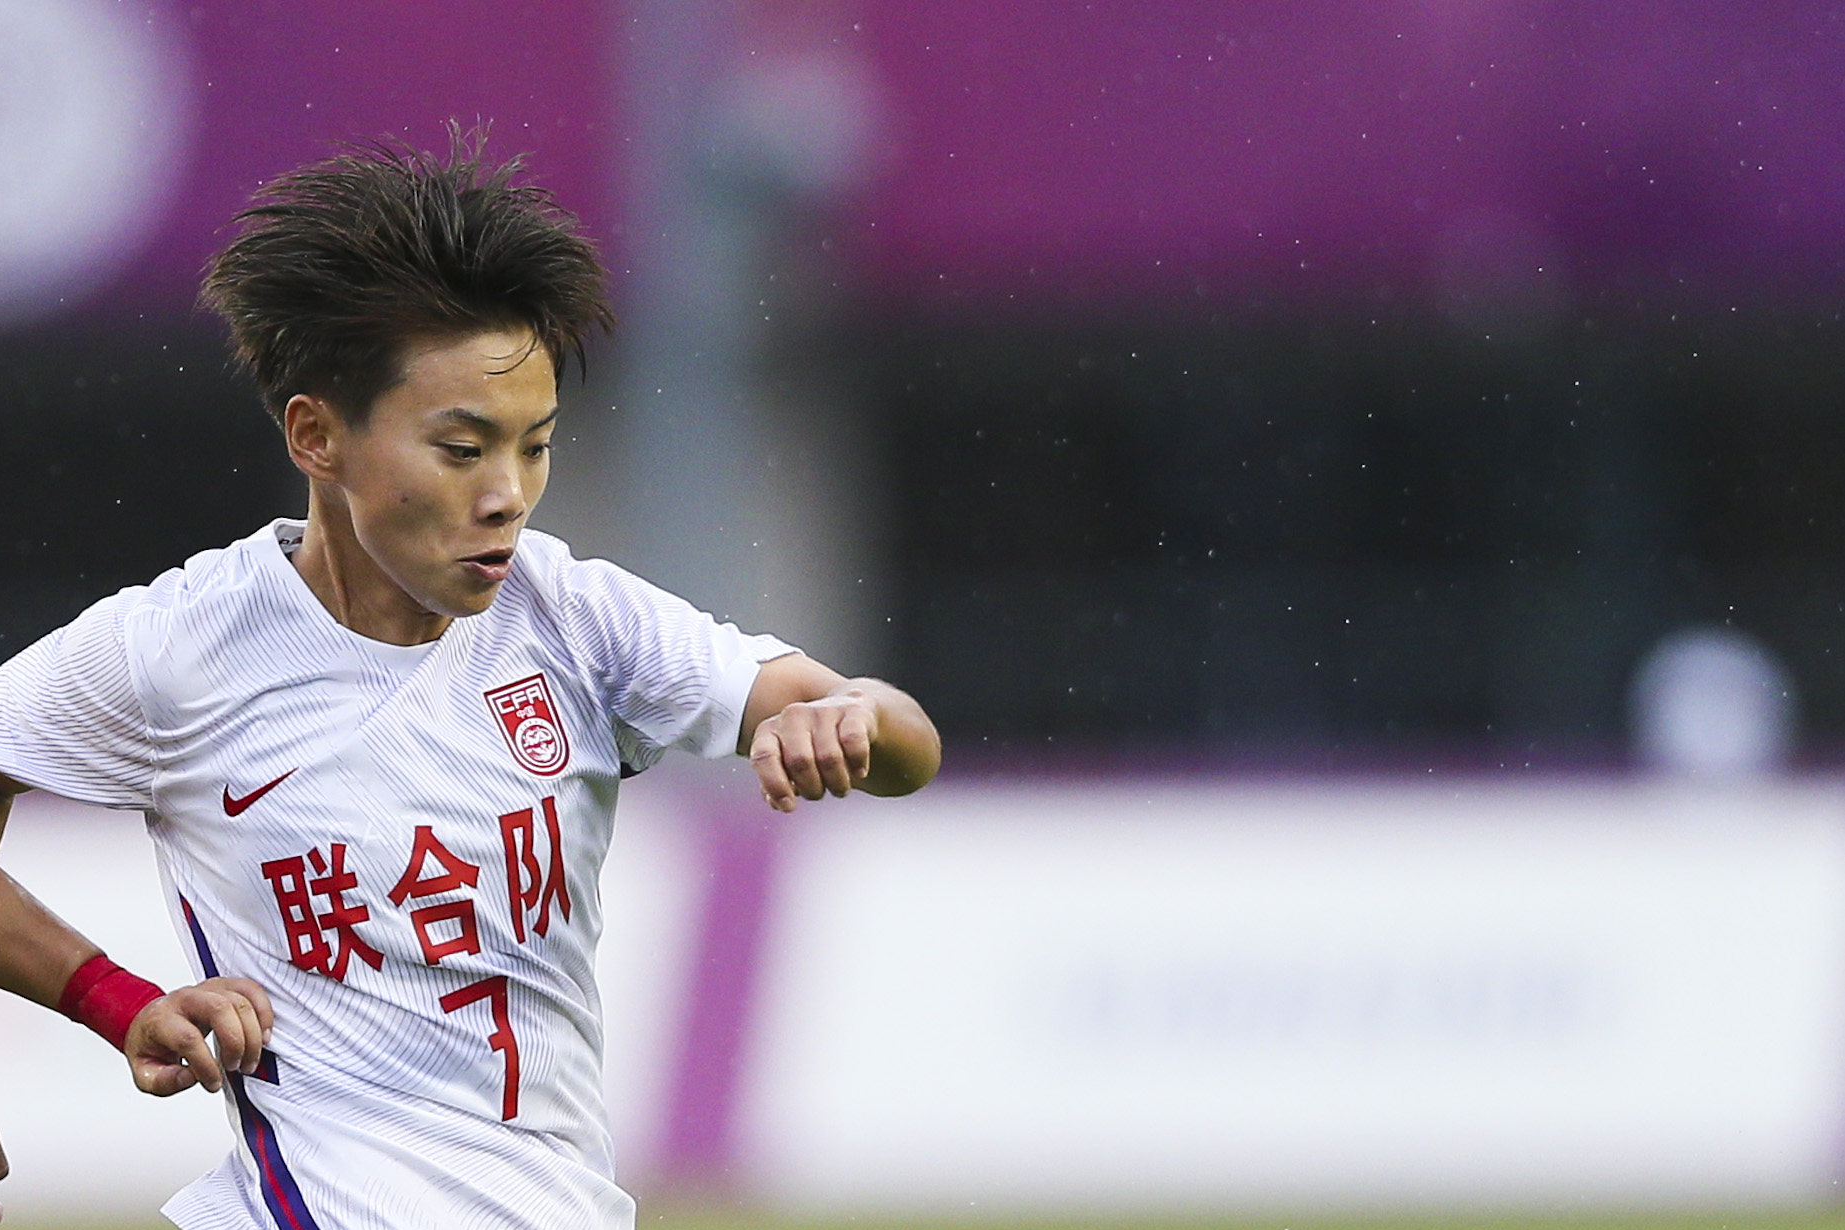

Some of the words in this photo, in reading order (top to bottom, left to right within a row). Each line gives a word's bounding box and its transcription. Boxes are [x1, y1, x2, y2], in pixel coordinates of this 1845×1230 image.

[495, 686, 544, 714] CFA
[261, 795, 572, 984] 联合队
[438, 974, 521, 1122] 7
